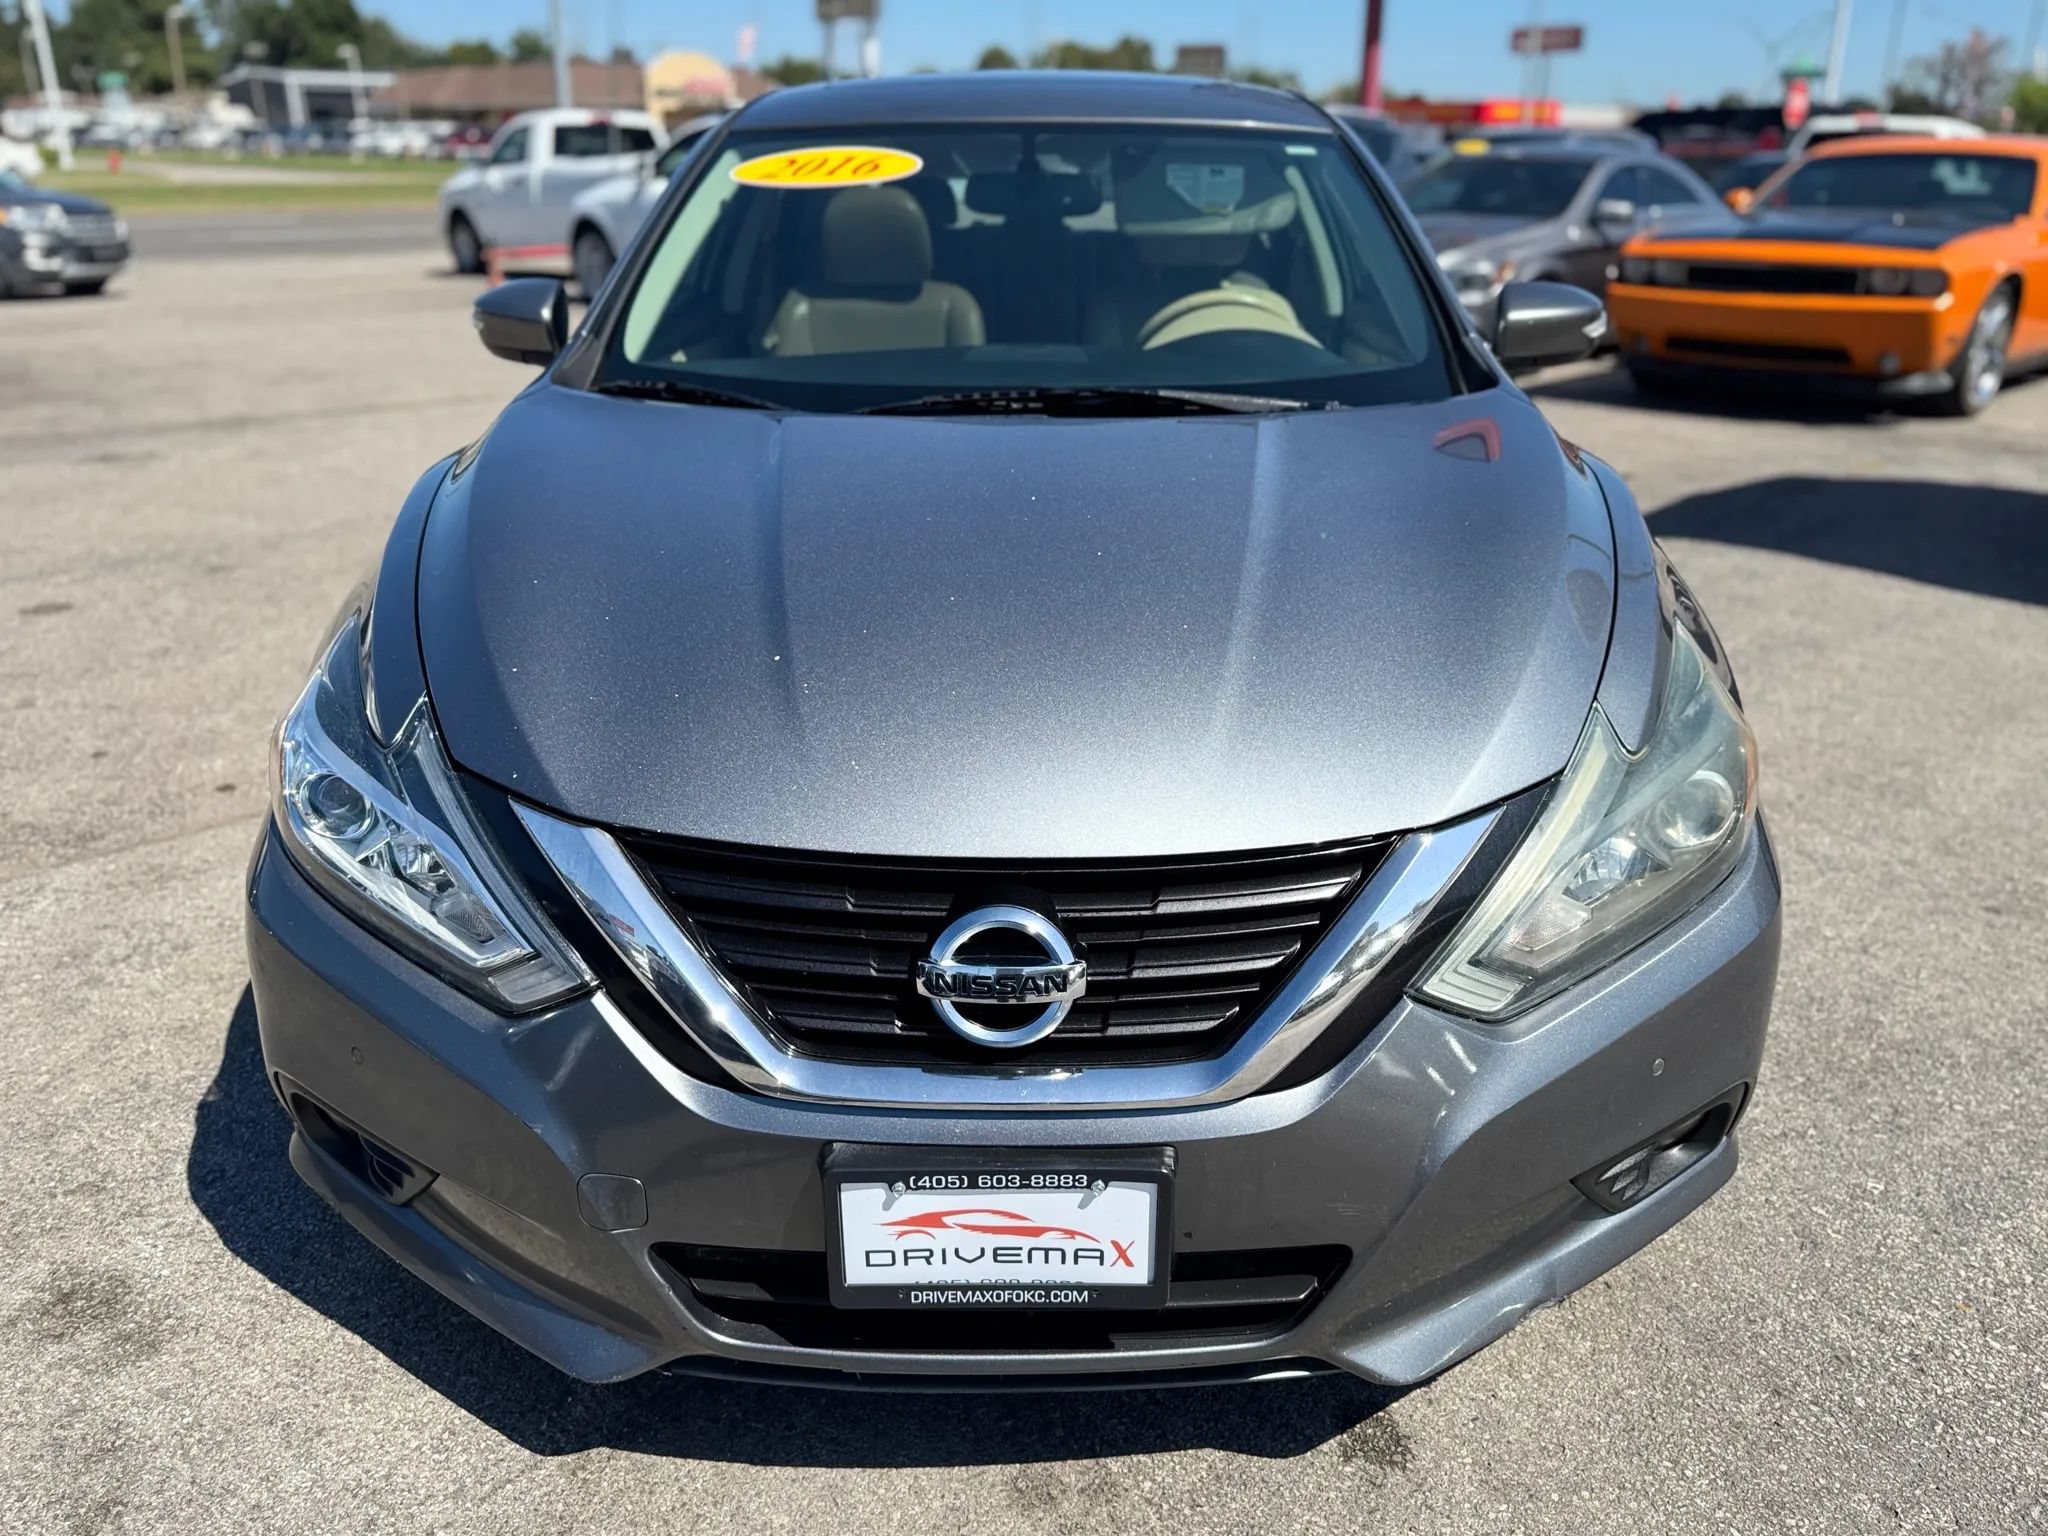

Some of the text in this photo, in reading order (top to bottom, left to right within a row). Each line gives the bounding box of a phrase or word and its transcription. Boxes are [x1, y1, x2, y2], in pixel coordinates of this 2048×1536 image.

[755, 155, 885, 180] 2016
[933, 972, 1068, 997] NISSAN
[909, 1174, 1088, 1189] (405) 603-8883
[865, 1240, 1135, 1268] DRIVEMAX
[911, 1290, 1089, 1304] DRIVEMAXOFOKC.COM
